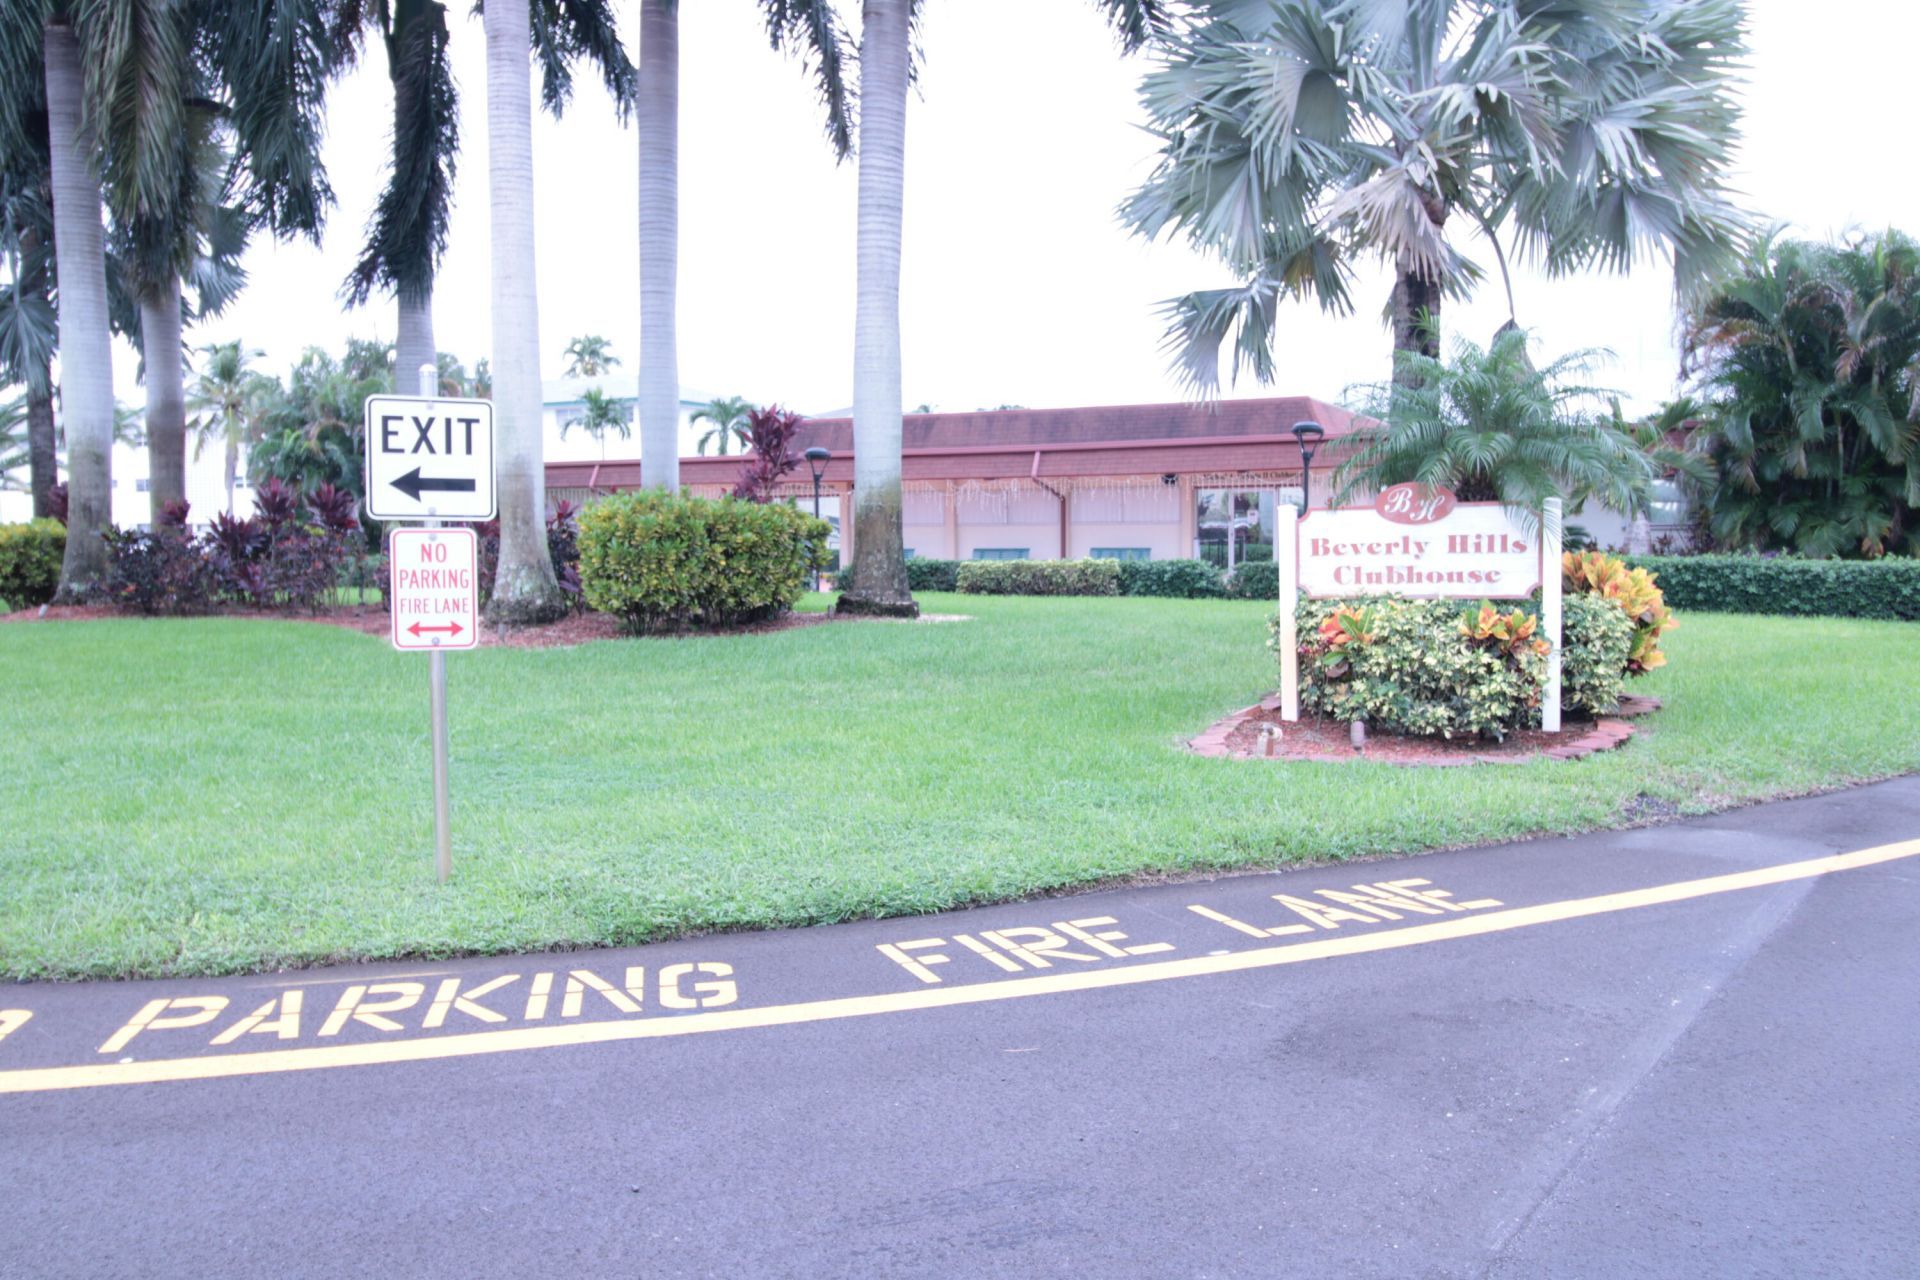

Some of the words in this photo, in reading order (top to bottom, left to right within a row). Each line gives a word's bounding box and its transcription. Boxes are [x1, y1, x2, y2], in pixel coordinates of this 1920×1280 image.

[381, 415, 480, 455] EXIT
[420, 543, 447, 563] NO
[1310, 535, 1430, 560] Beverly
[1448, 534, 1528, 554] Hills
[399, 569, 469, 588] PARKING
[1333, 566, 1502, 585] Clubhouse
[400, 598, 430, 614] FIRE
[434, 598, 469, 614] LANE
[98, 962, 738, 1053] PARKING
[876, 916, 1176, 983] FIRE
[1187, 878, 1504, 938] LANE
